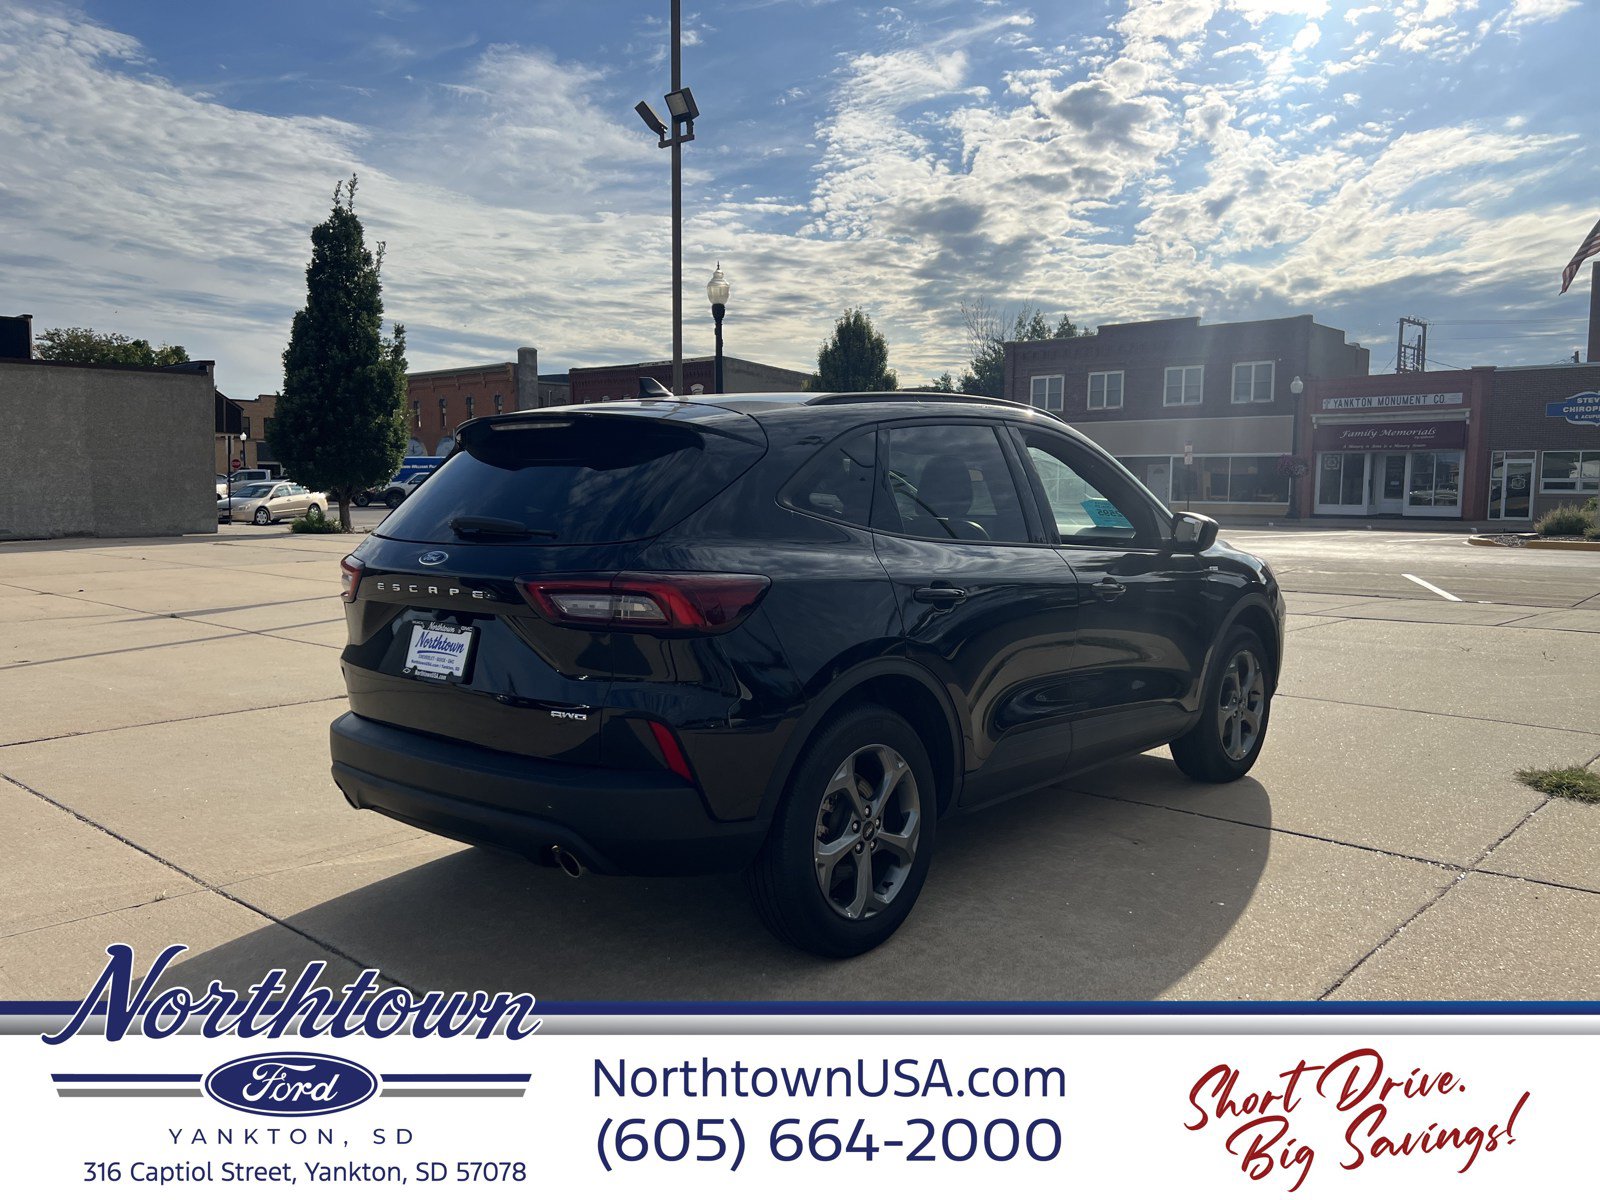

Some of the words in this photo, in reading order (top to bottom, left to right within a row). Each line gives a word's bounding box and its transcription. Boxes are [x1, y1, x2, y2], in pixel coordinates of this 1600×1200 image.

[1333, 397, 1373, 409] YANKTON
[1377, 394, 1428, 407] MONUMENT
[1562, 405, 1600, 413] CHIROP
[1340, 428, 1378, 439] Family
[1379, 426, 1437, 437] Memorials
[376, 582, 484, 599] ESCAPE
[415, 631, 465, 654] Northtown
[550, 710, 587, 721] AWD
